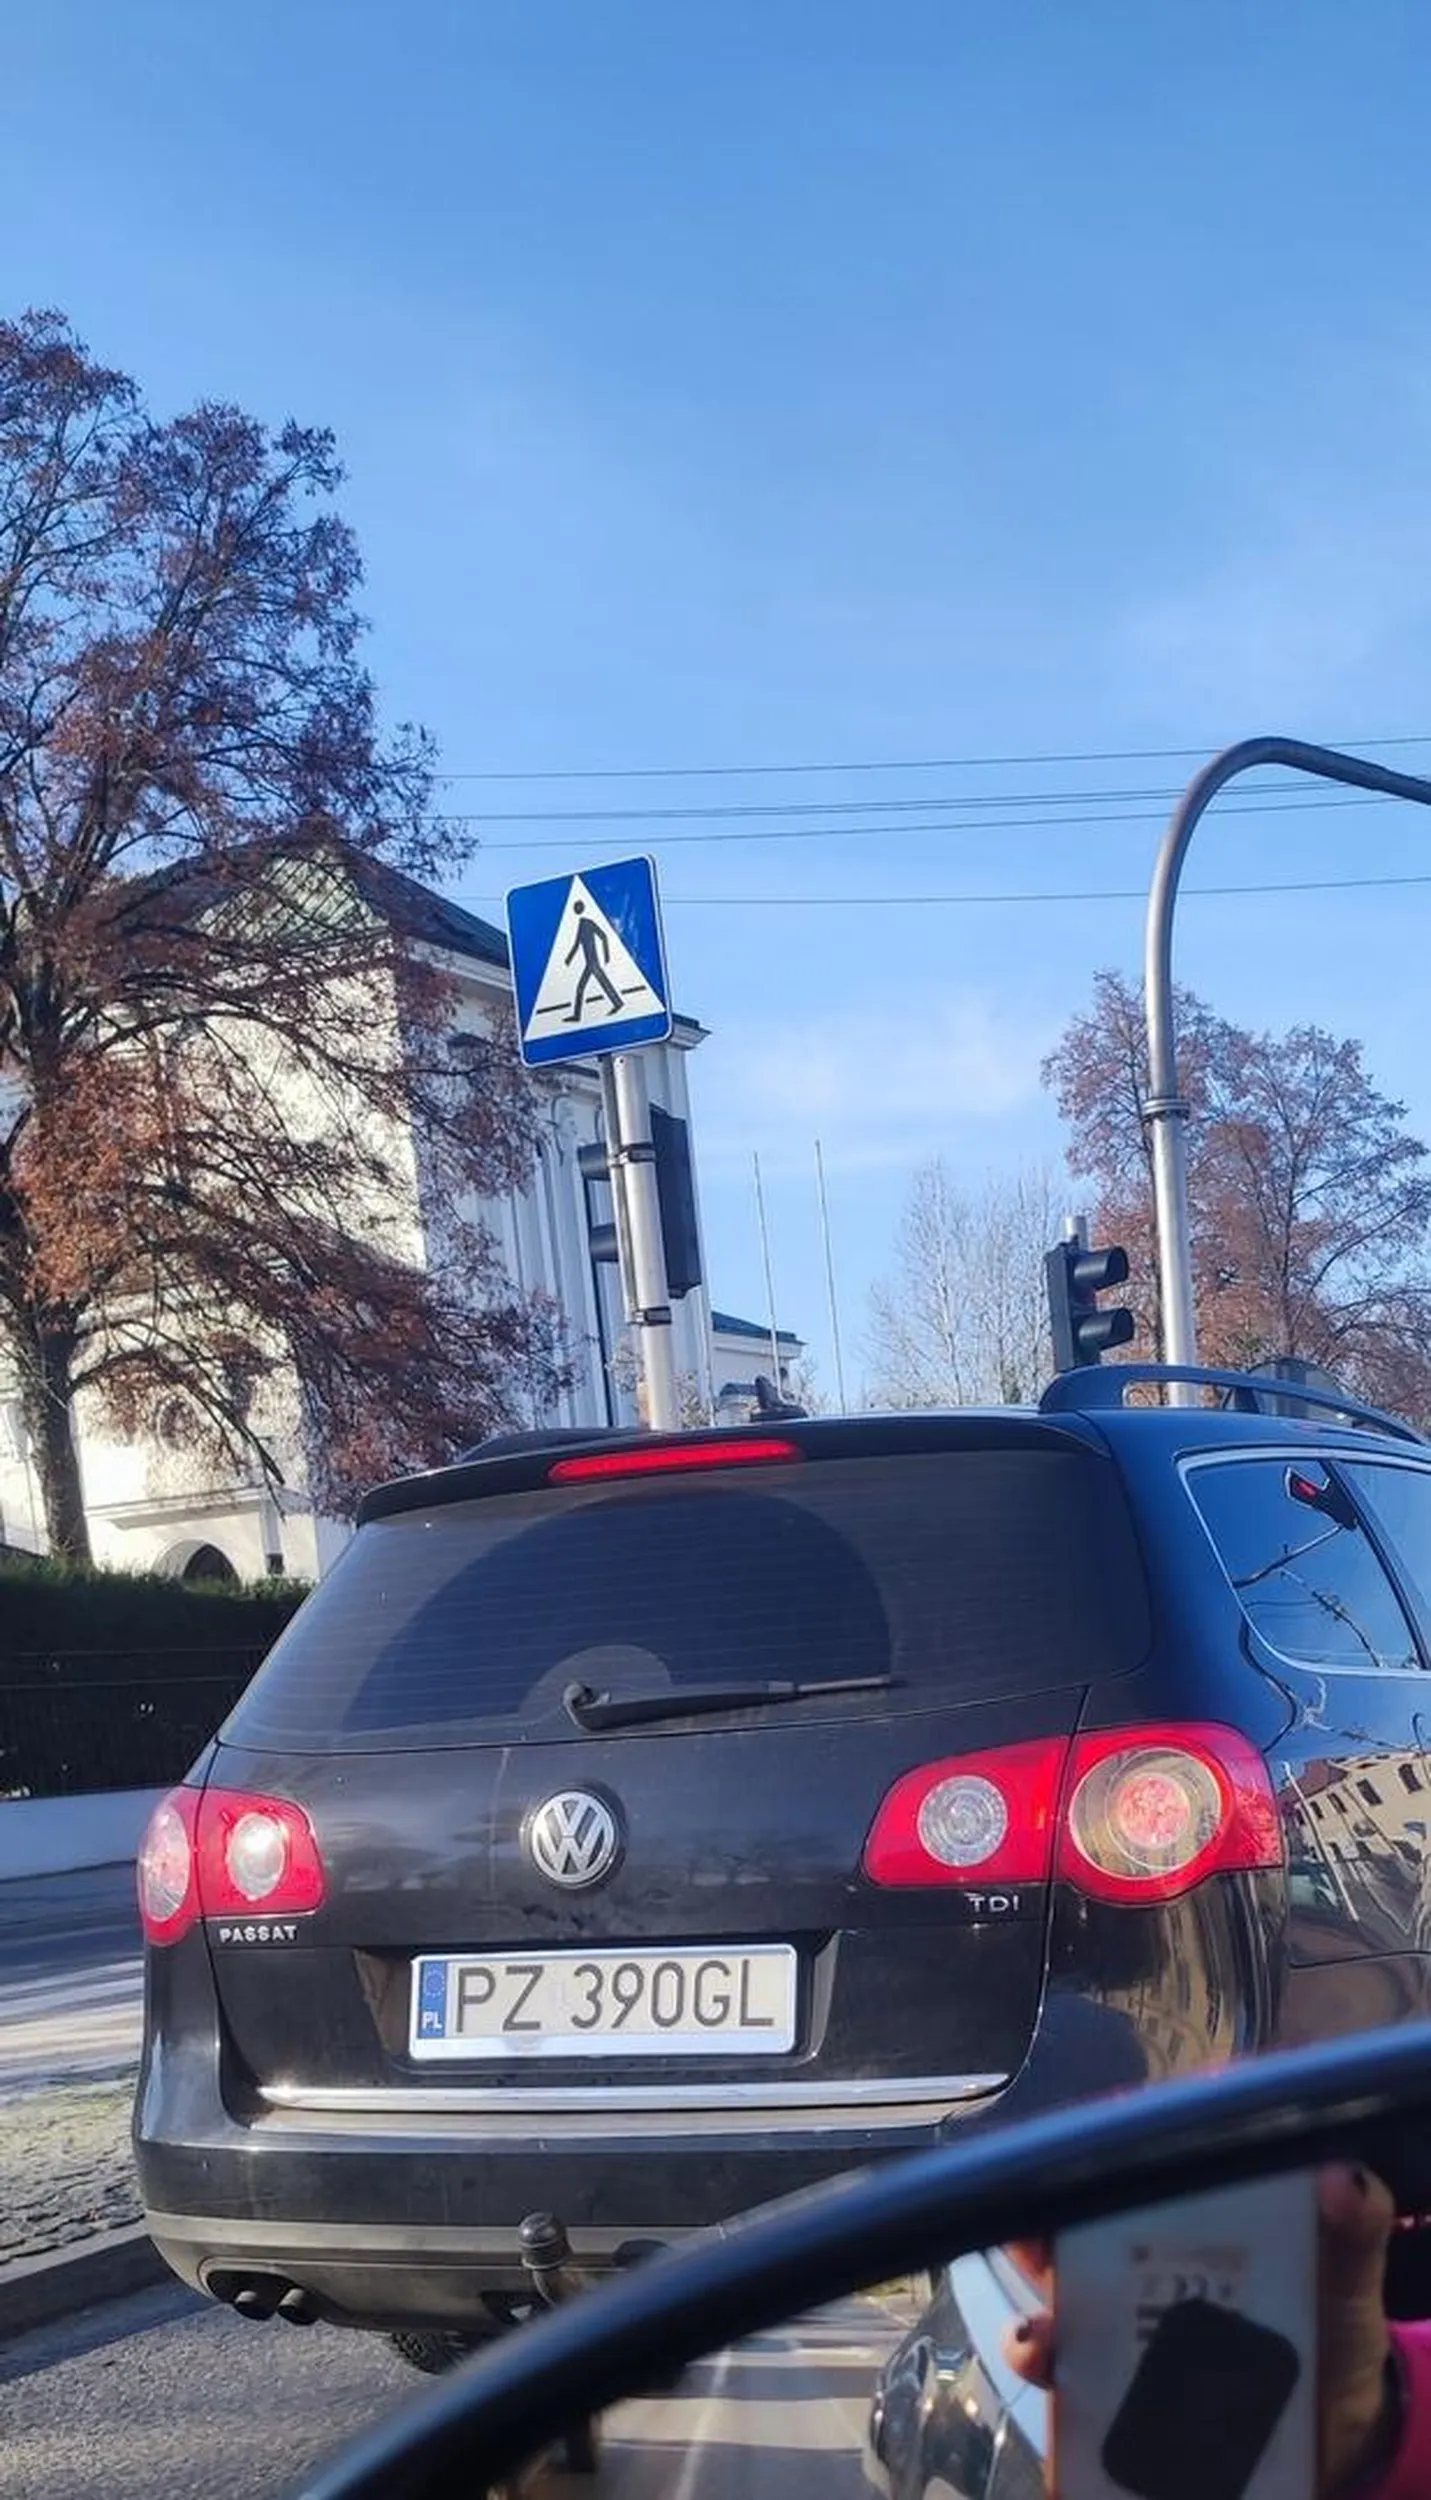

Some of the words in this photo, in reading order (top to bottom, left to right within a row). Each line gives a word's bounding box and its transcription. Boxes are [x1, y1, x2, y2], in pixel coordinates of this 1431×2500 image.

[532, 1791, 615, 1883] VW
[968, 1894, 1019, 1913] TDI
[219, 1924, 297, 1943] PASSAT
[456, 1964, 545, 2033] PZ
[570, 1958, 775, 2030] 390GL
[421, 2010, 443, 2031] PL
